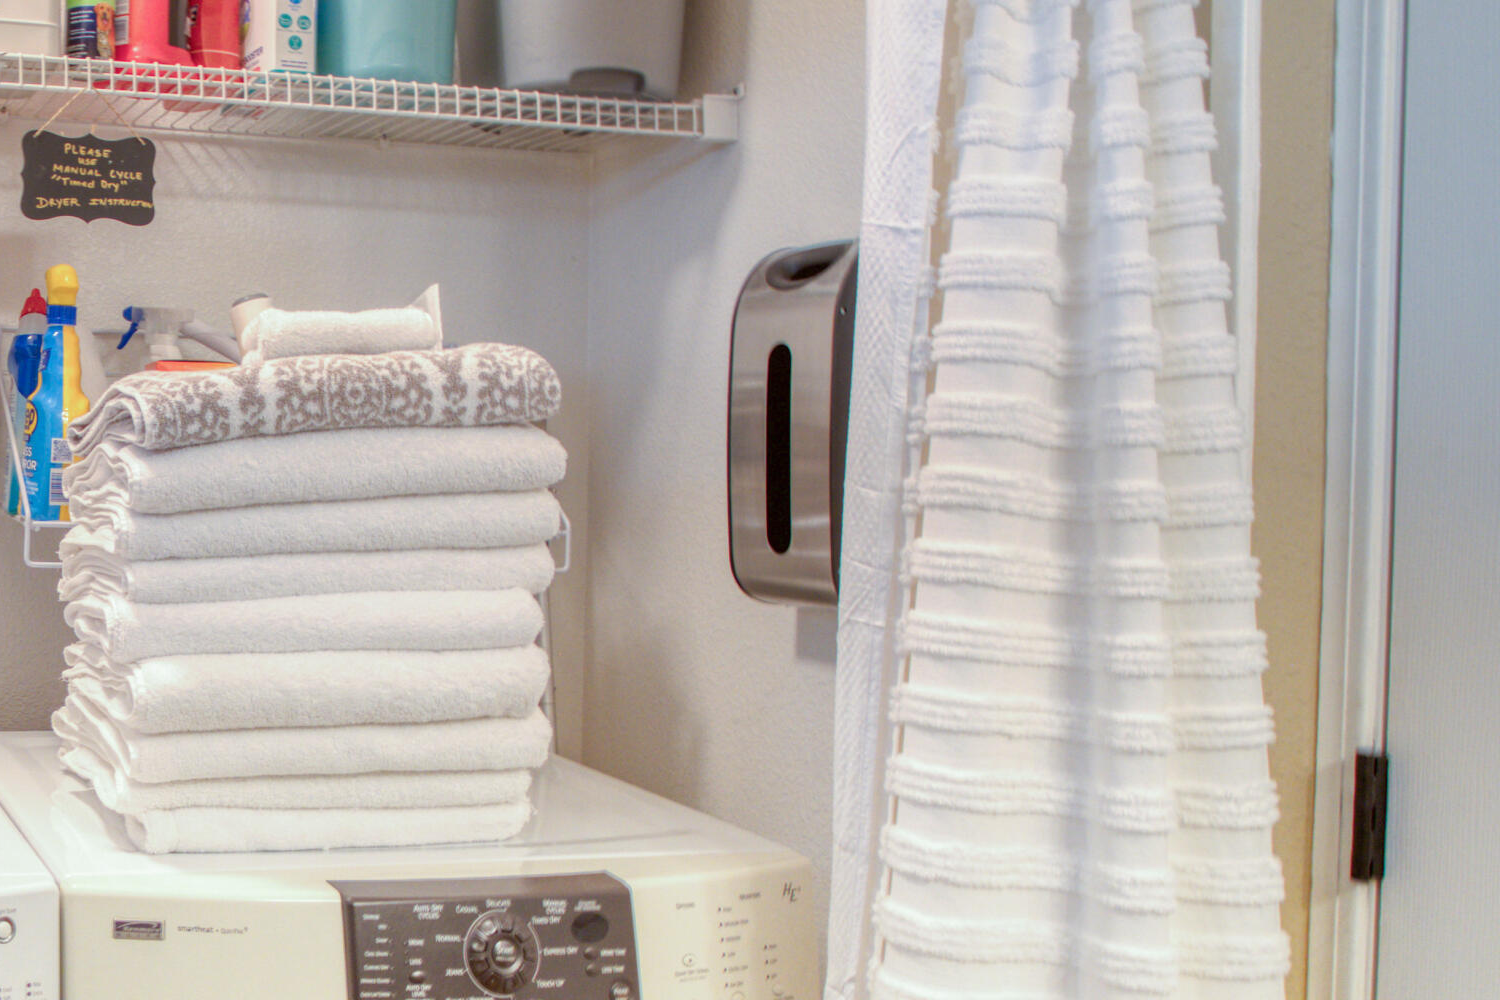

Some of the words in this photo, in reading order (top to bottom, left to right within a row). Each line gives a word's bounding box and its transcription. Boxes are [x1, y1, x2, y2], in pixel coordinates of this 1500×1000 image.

[64, 143, 112, 158] PLEASE
[78, 158, 98, 166] USE
[52, 164, 102, 176] MANUAL
[110, 169, 142, 181] CYCLE
[36, 197, 81, 209] DRYER
